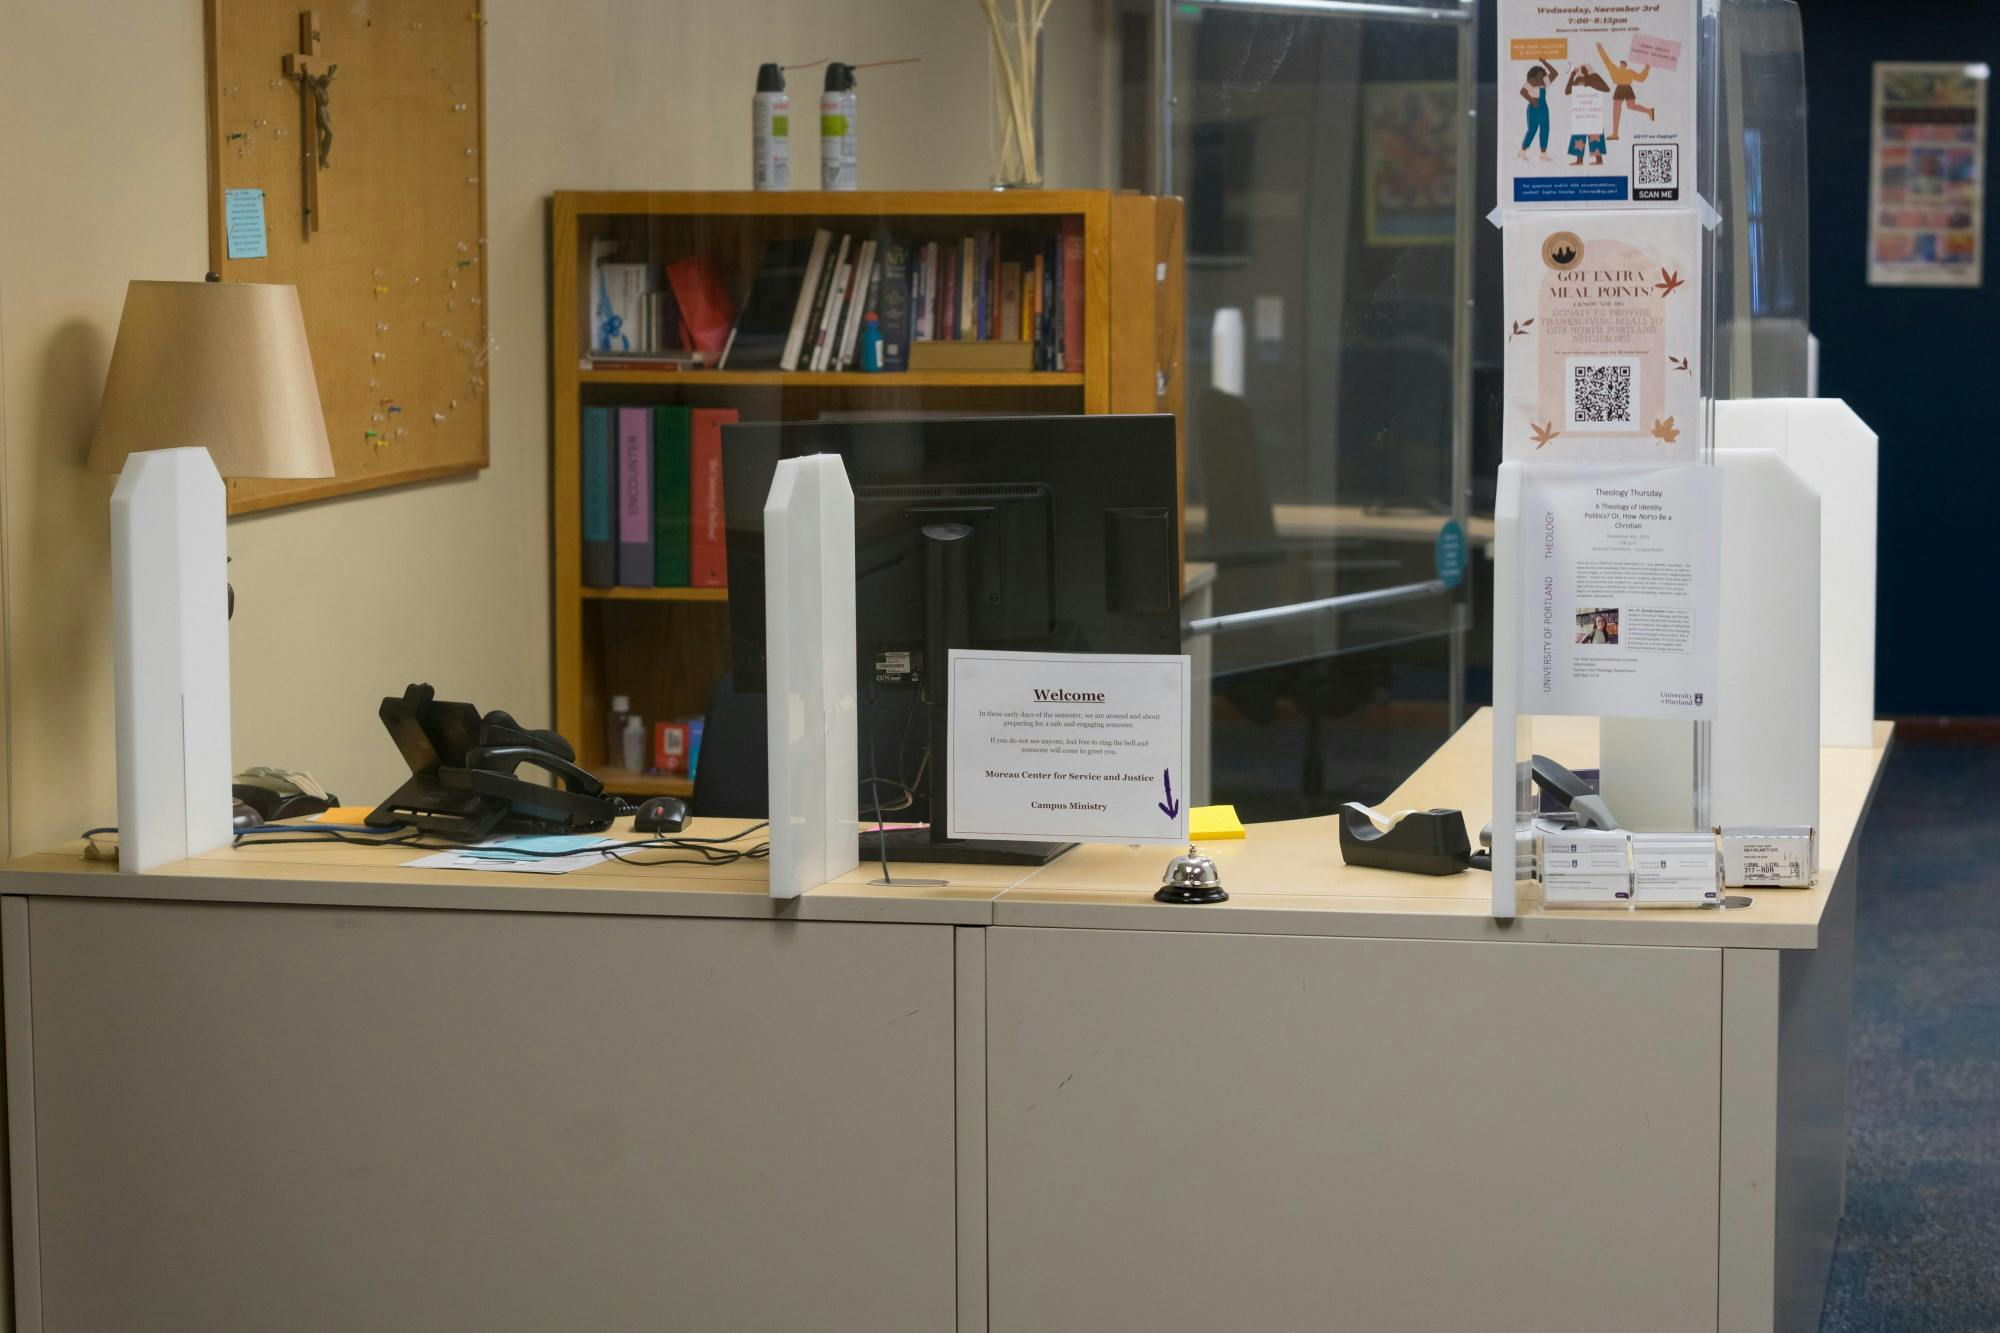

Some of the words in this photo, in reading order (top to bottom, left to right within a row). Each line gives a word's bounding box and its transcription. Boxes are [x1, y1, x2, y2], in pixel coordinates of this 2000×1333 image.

[1558, 271, 1586, 282] GOT
[1594, 271, 1645, 282] EXTRA
[1550, 287, 1592, 298] MEAL
[1598, 287, 1654, 298] POINTS?
[1552, 308, 1592, 316] DONATE
[628, 436, 638, 516] ENCOUNTER
[1596, 489, 1628, 498] Theology
[1630, 489, 1663, 498] Thursday
[1612, 513, 1620, 521] Or,
[1544, 511, 1554, 559] THEOLOGY
[1544, 576, 1553, 624] PORTLAND
[1544, 628, 1552, 638] OF
[1544, 640, 1552, 692] UNIVERSITY
[1034, 689, 1105, 702] Welcome
[1004, 710, 1019, 718] early
[1100, 739, 1112, 747] ring
[985, 770, 1020, 779] Moreau
[1022, 770, 1052, 780] Center
[1054, 771, 1068, 780] for
[1068, 772, 1102, 781] Service
[1103, 772, 1120, 781] and
[1122, 773, 1154, 782] Justice
[1031, 801, 1067, 812] Campus
[1069, 802, 1108, 812] Ministry
